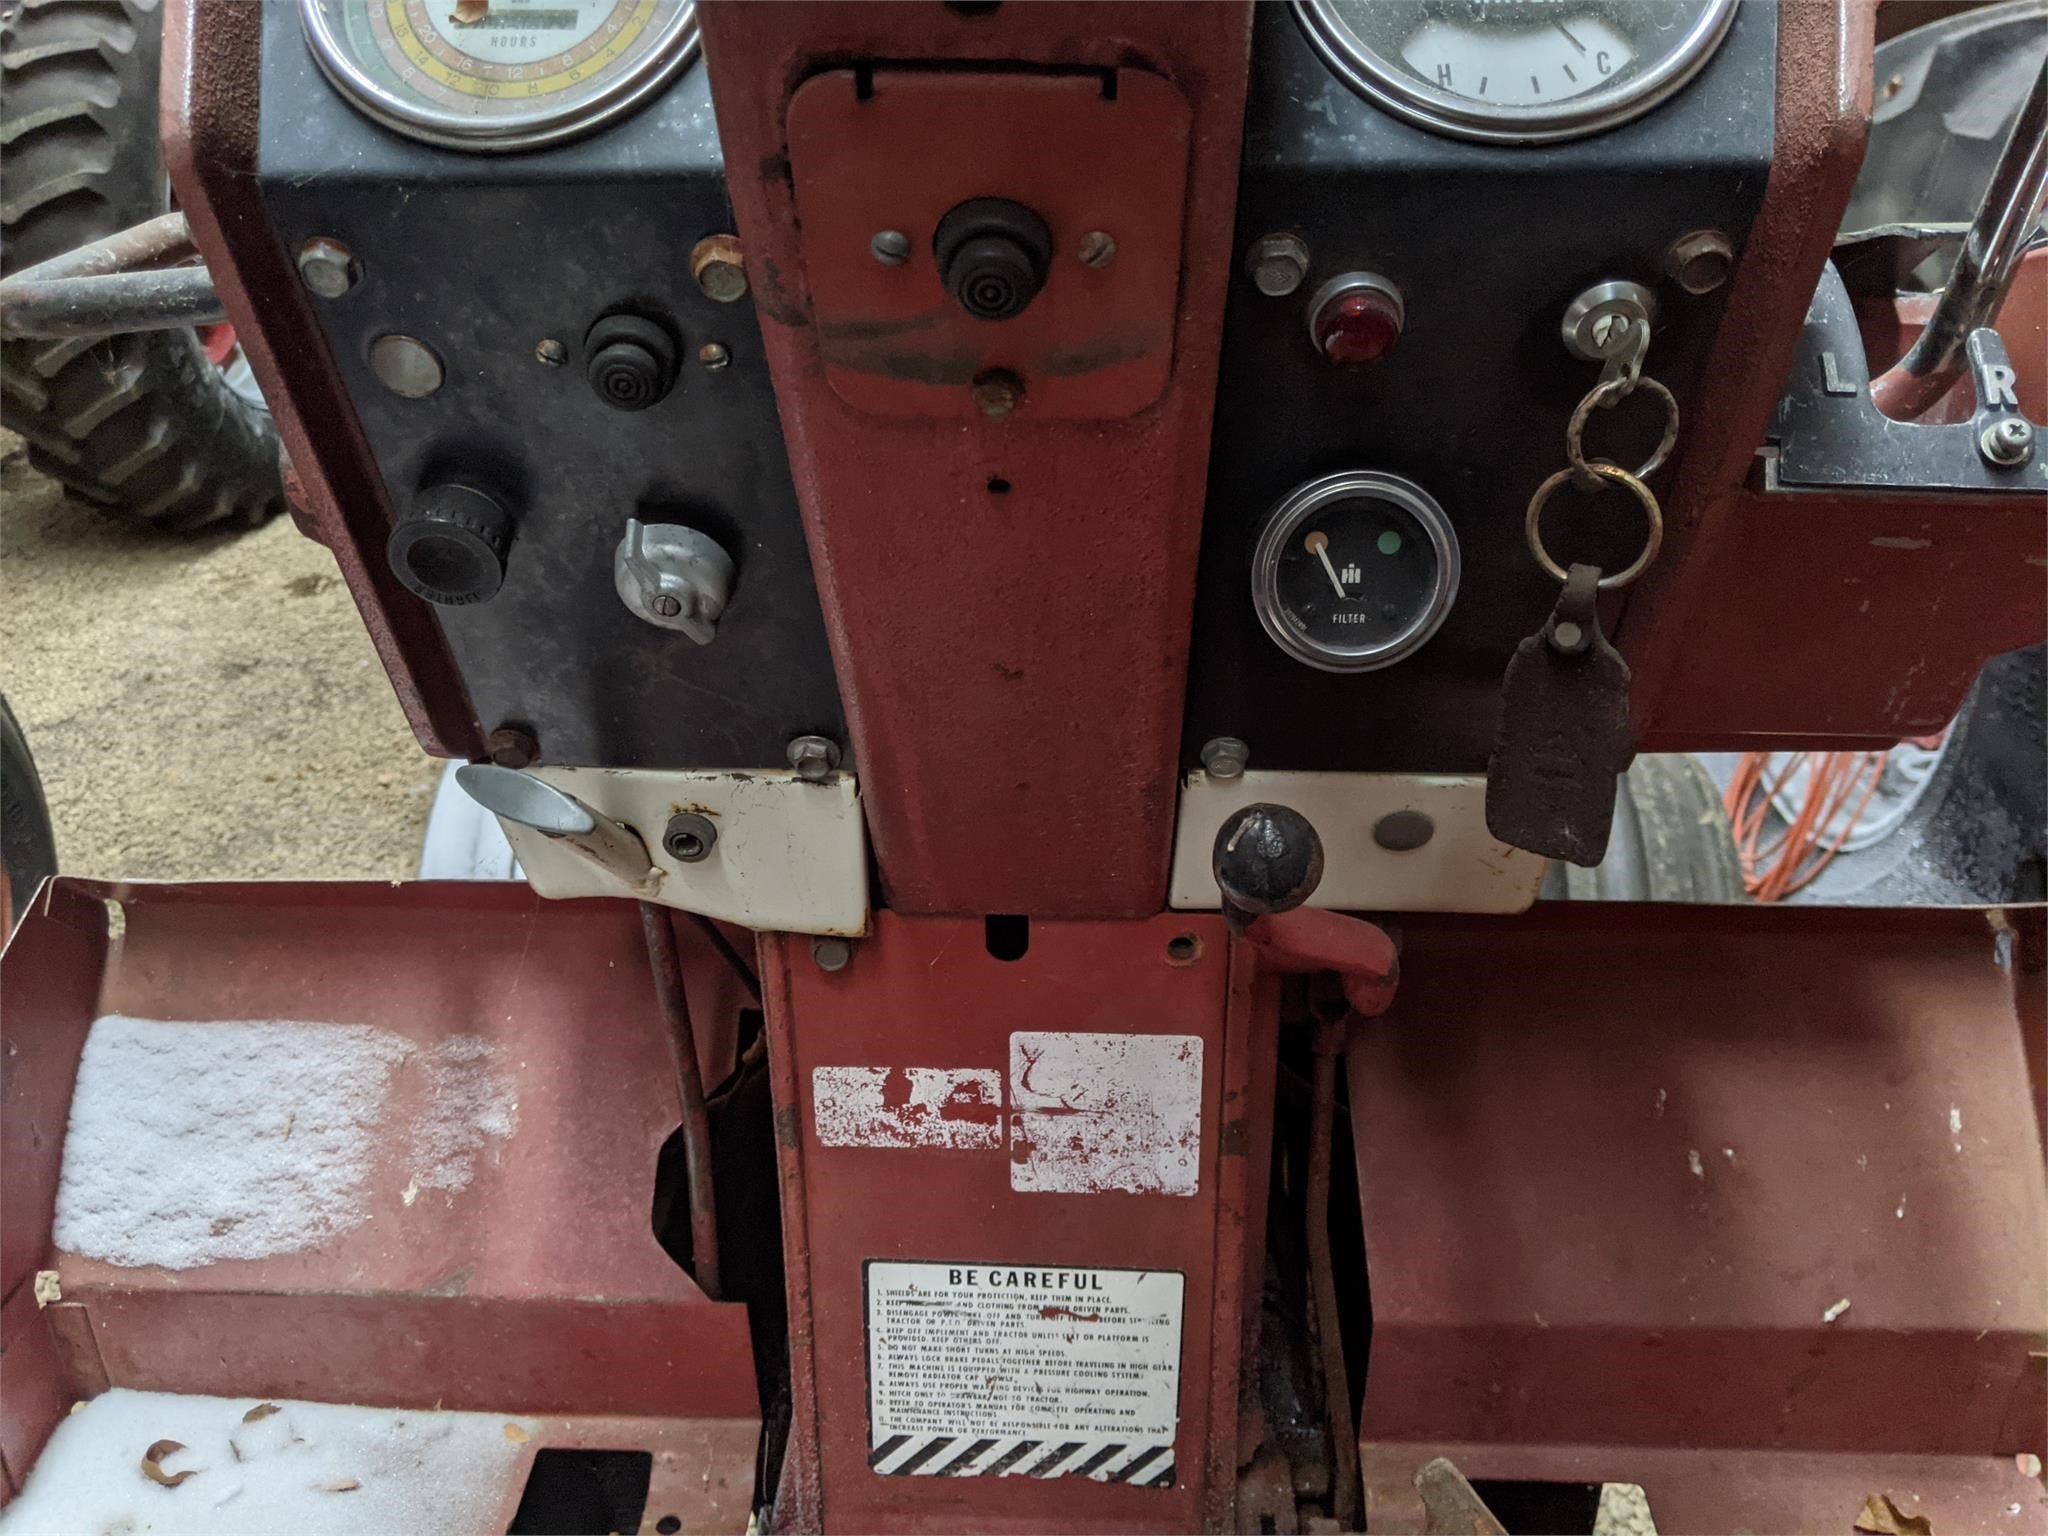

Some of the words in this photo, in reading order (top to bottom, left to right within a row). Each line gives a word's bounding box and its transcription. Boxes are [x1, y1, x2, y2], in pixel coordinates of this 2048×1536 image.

[490, 36, 537, 48] HOURS
[417, 25, 437, 43] 20
[457, 57, 473, 71] 16
[508, 68, 523, 79] 12
[561, 55, 574, 67] 8
[1437, 63, 1452, 88] H
[1596, 51, 1612, 75] C
[1821, 352, 1857, 397] L
[1982, 365, 2019, 410] R
[1332, 613, 1366, 624] FILTER
[949, 1269, 979, 1286] BE
[989, 1270, 1103, 1290] CAREFUL
[918, 1290, 931, 1298] ARE
[952, 1291, 974, 1299] YOUR
[977, 1302, 1014, 1310] CLOTHING
[887, 1309, 928, 1317] DISENGAGE
[1100, 1316, 1126, 1324] BEFORE
[925, 1329, 969, 1337] IMPLEMENT
[975, 1347, 999, 1355] TURNS
[1003, 1358, 1041, 1366] TOGETHER
[1045, 1360, 1072, 1368] BEFORE
[1076, 1361, 1114, 1369] TRAVELING
[909, 1364, 944, 1372] MACHINE
[1074, 1370, 1108, 1378] COOLING
[923, 1372, 961, 1380] RADIATOR
[940, 1382, 968, 1390] PROPER
[976, 1403, 1007, 1411] MANUAL
[1074, 1407, 1116, 1415] OPERATING
[890, 1424, 923, 1432] INCREASE
[927, 1425, 953, 1433] POWER
[906, 1416, 942, 1424] COMPANY
[1002, 1421, 1050, 1430] RESPONSIBLE
[1094, 1425, 1143, 1433] ALTERATIONS
